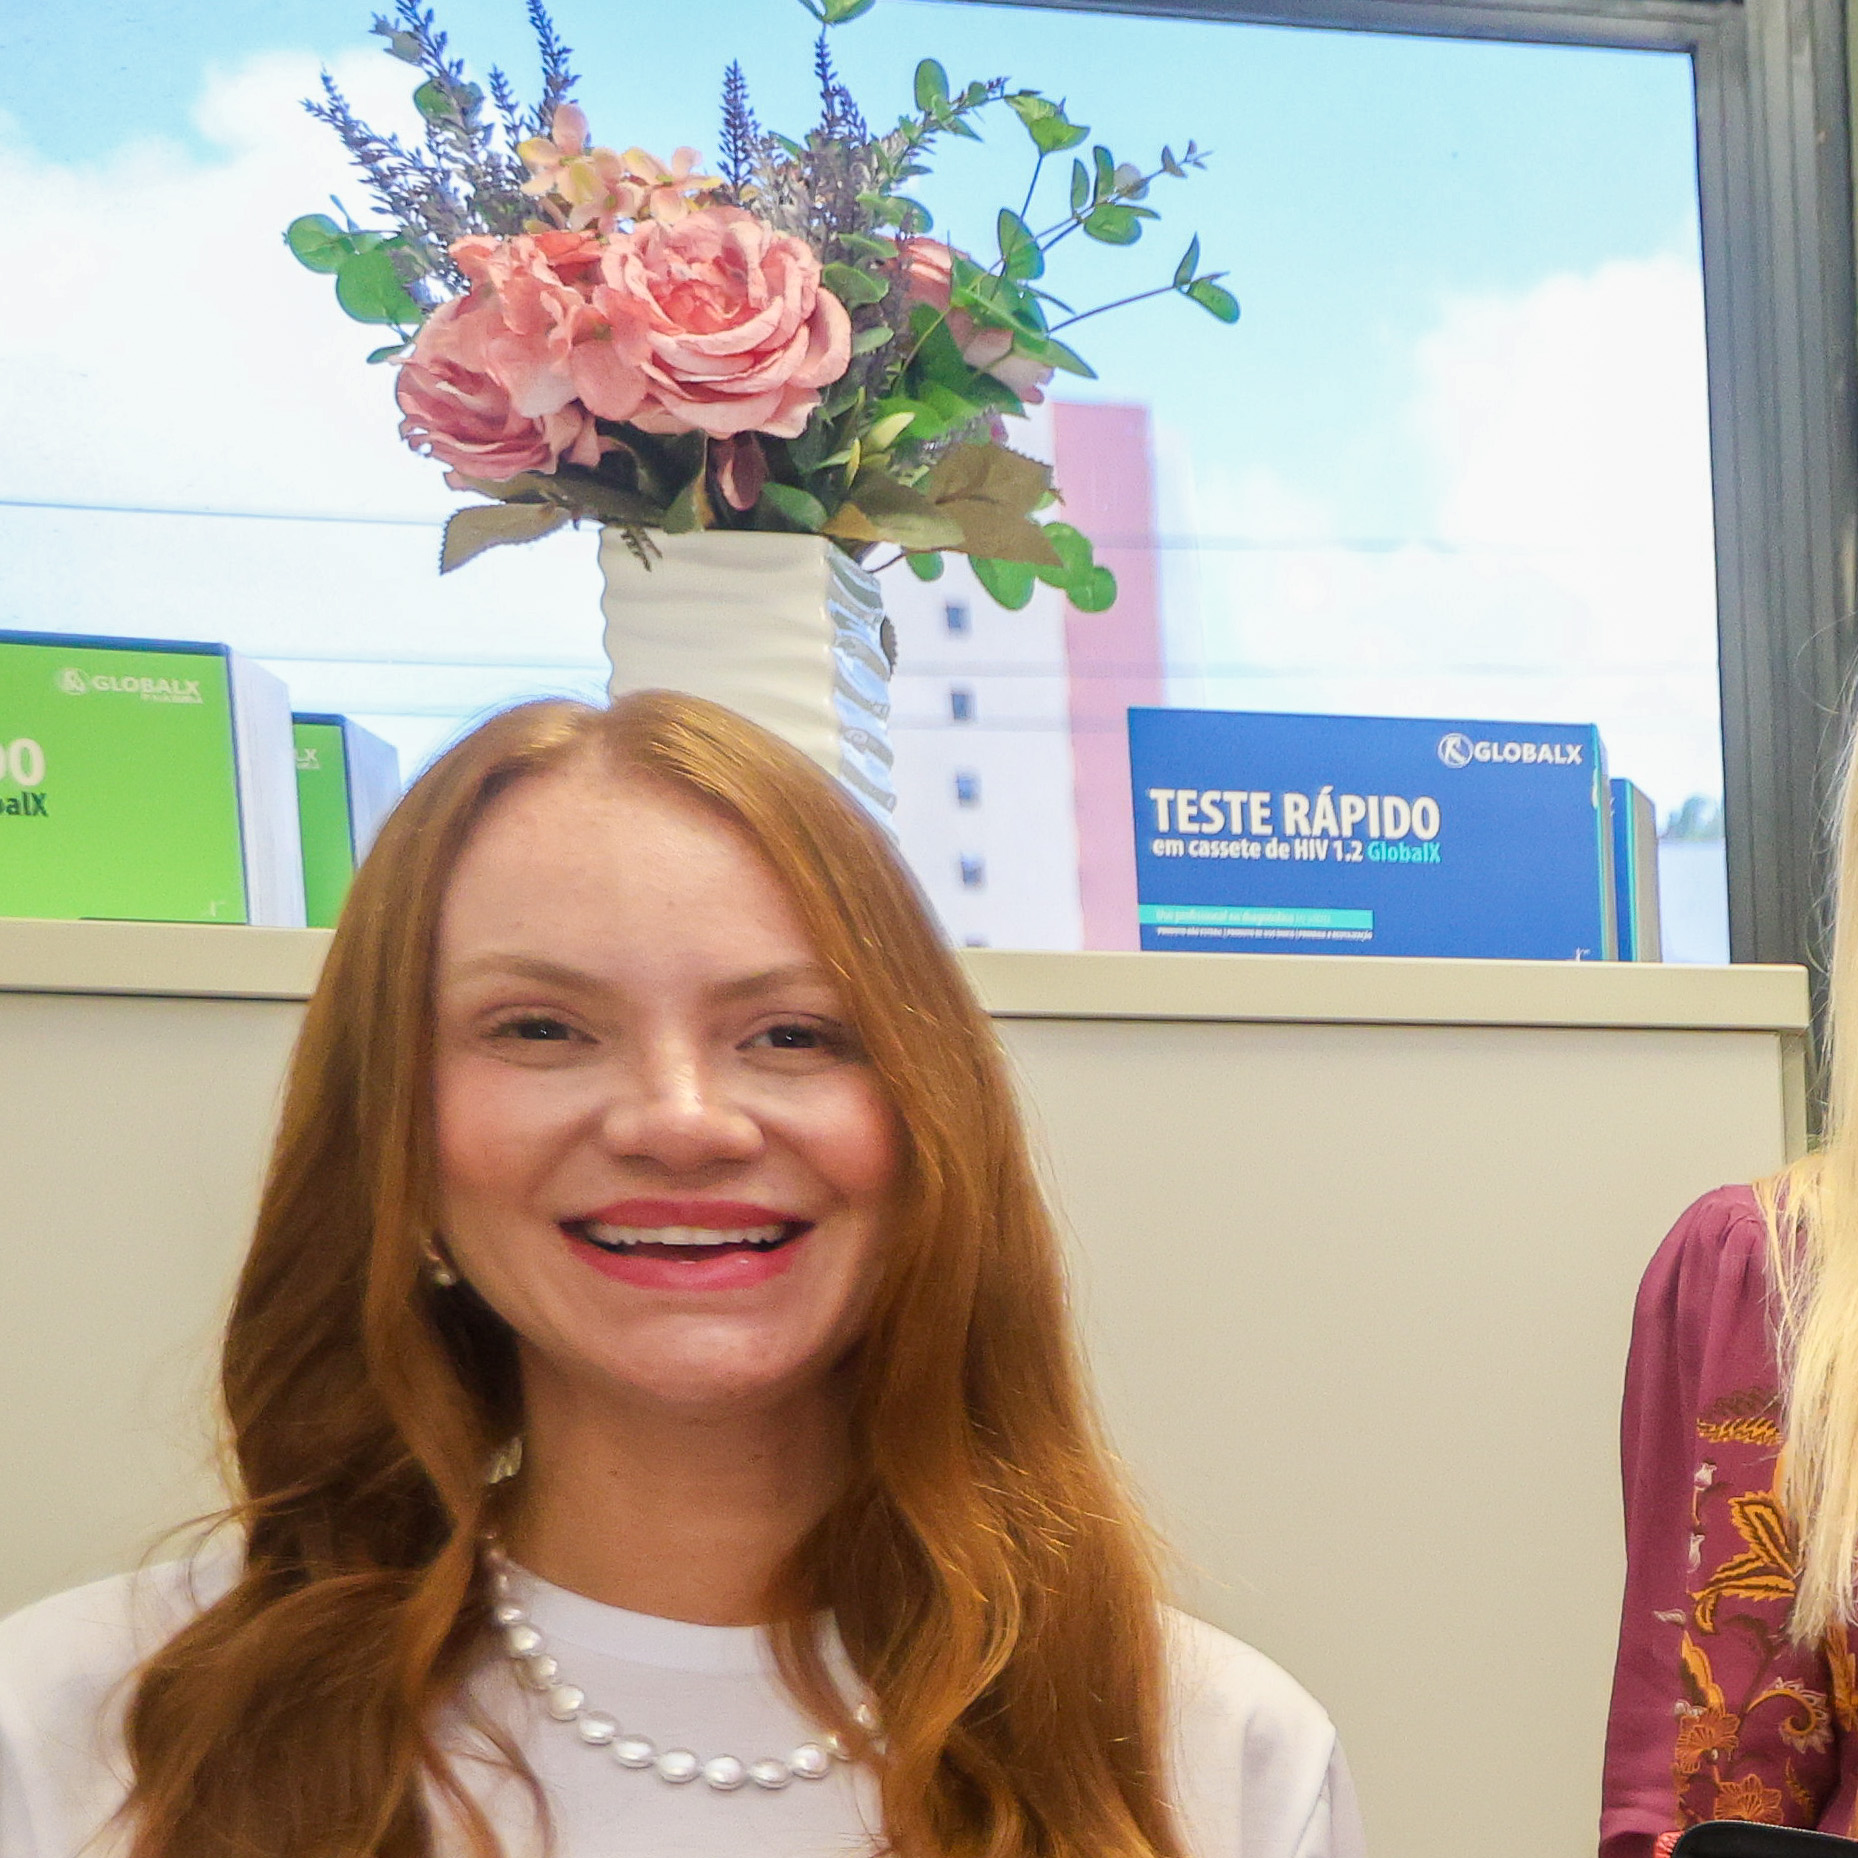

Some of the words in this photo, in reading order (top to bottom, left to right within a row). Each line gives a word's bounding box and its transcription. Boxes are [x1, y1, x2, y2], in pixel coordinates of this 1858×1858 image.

[92, 675, 199, 695] GLOBALX
[1474, 741, 1583, 765] GLOBALX
[0, 791, 49, 817] alX
[1150, 788, 1273, 836] TESTE
[1283, 785, 1440, 840] RÁPIDO
[1152, 838, 1184, 857] em
[1189, 839, 1261, 860] cassete
[1264, 837, 1291, 860] de
[1294, 840, 1328, 860] HIV
[1333, 840, 1363, 862] 1.2
[1367, 841, 1442, 864] GlobalX
